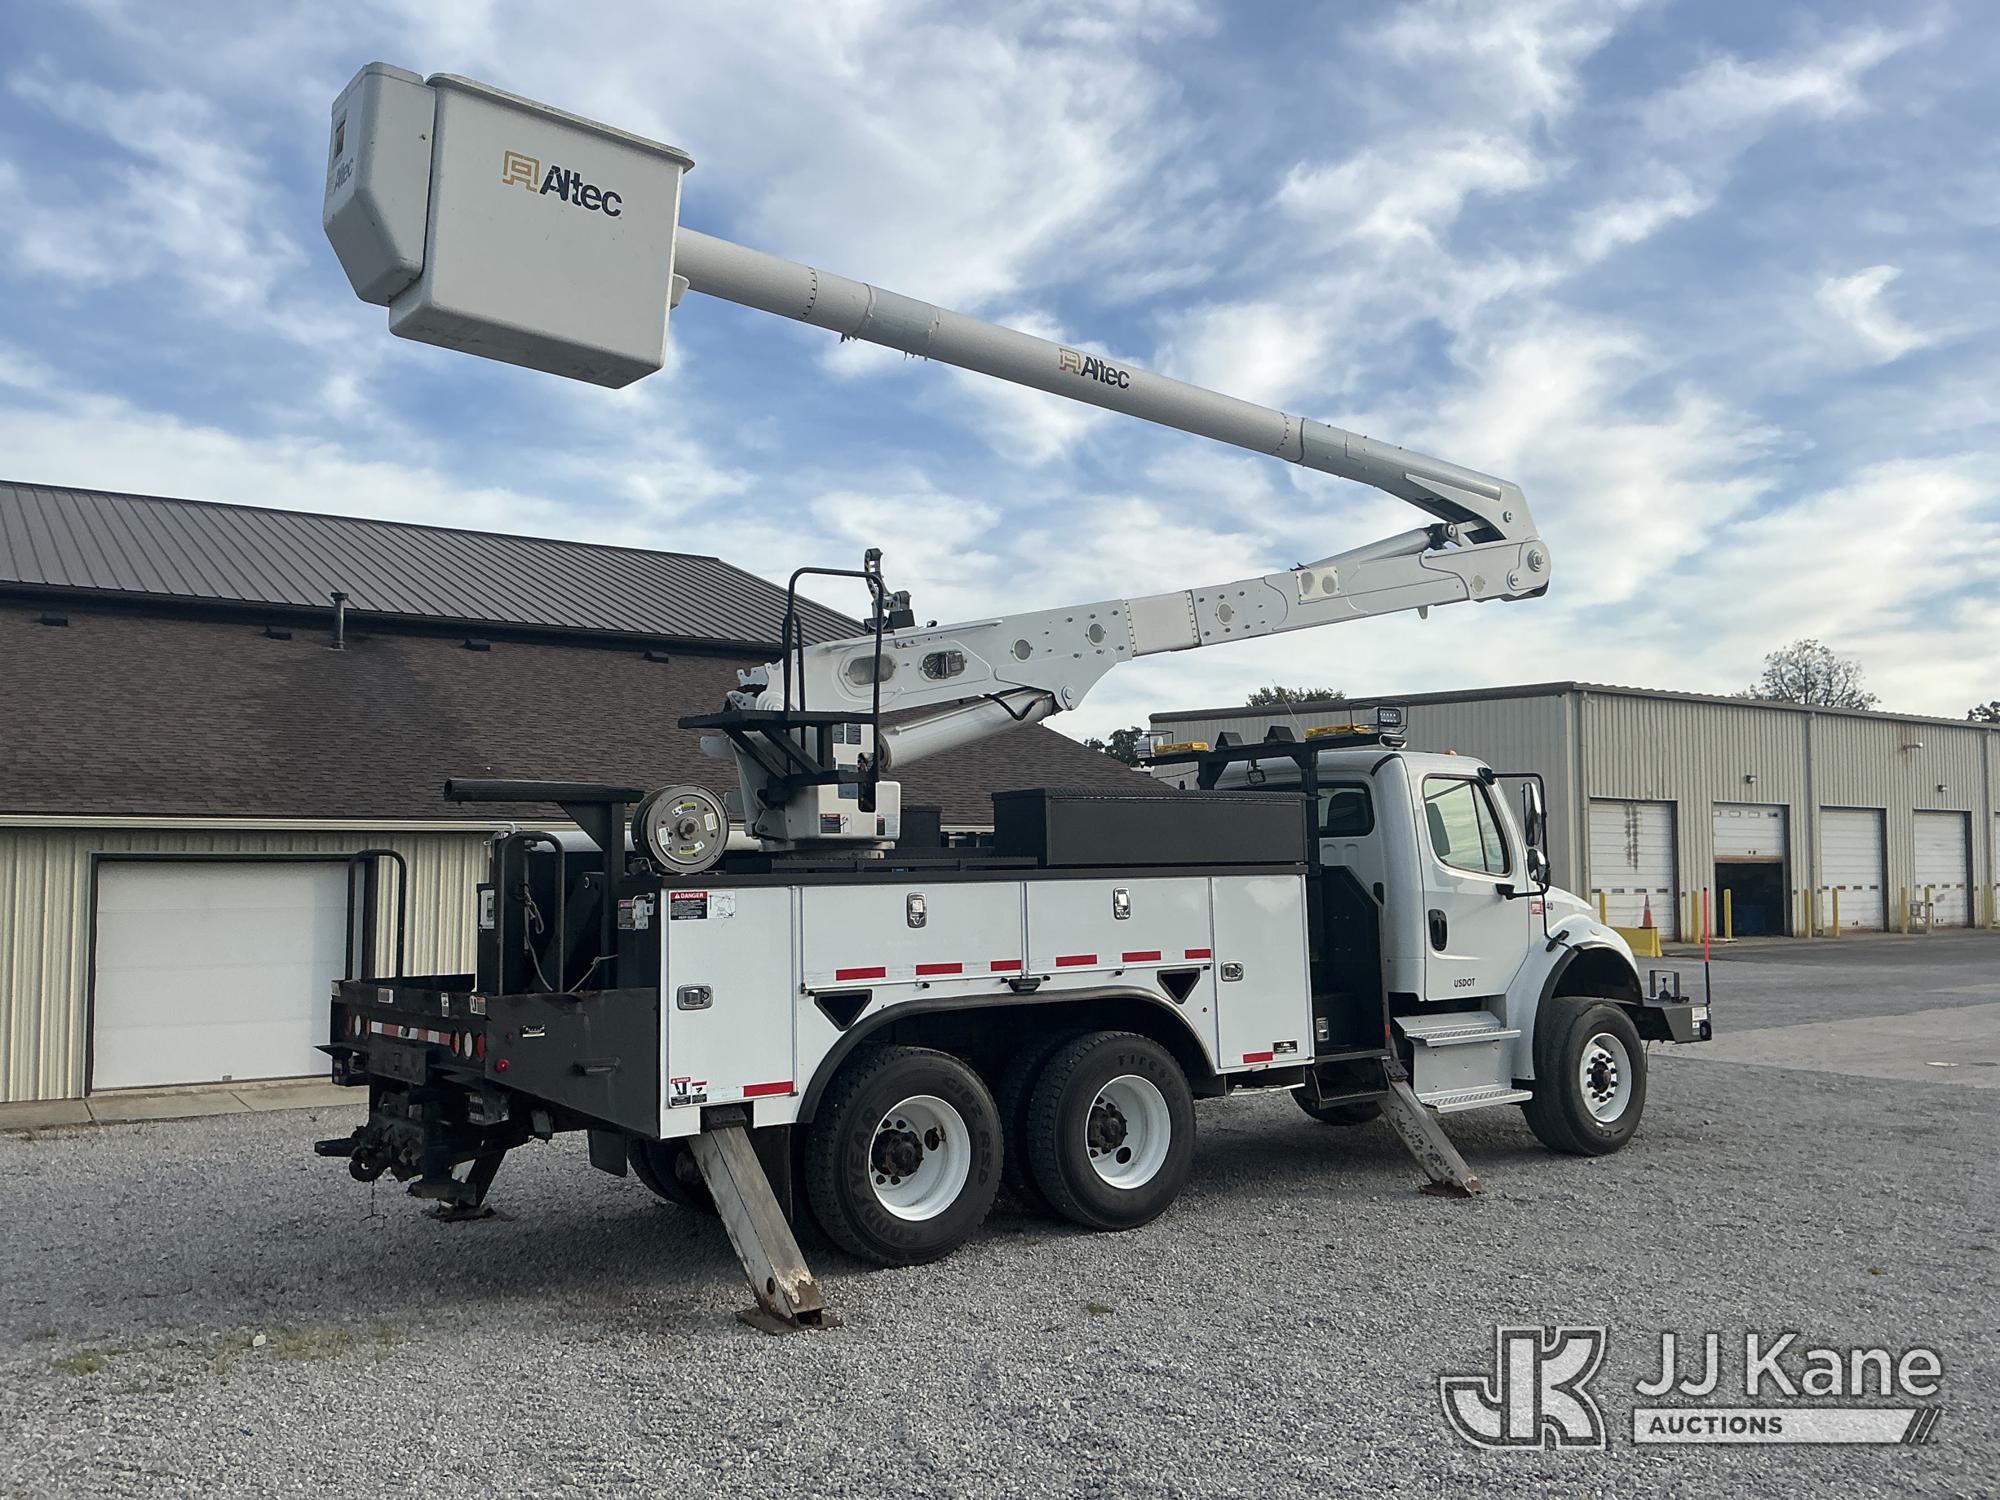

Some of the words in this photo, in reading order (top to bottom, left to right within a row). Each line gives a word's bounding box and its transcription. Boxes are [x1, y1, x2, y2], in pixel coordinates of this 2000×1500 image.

[540, 165, 622, 217] Altec
[1081, 356, 1130, 389] Altec
[1454, 978, 1475, 987] USDOT
